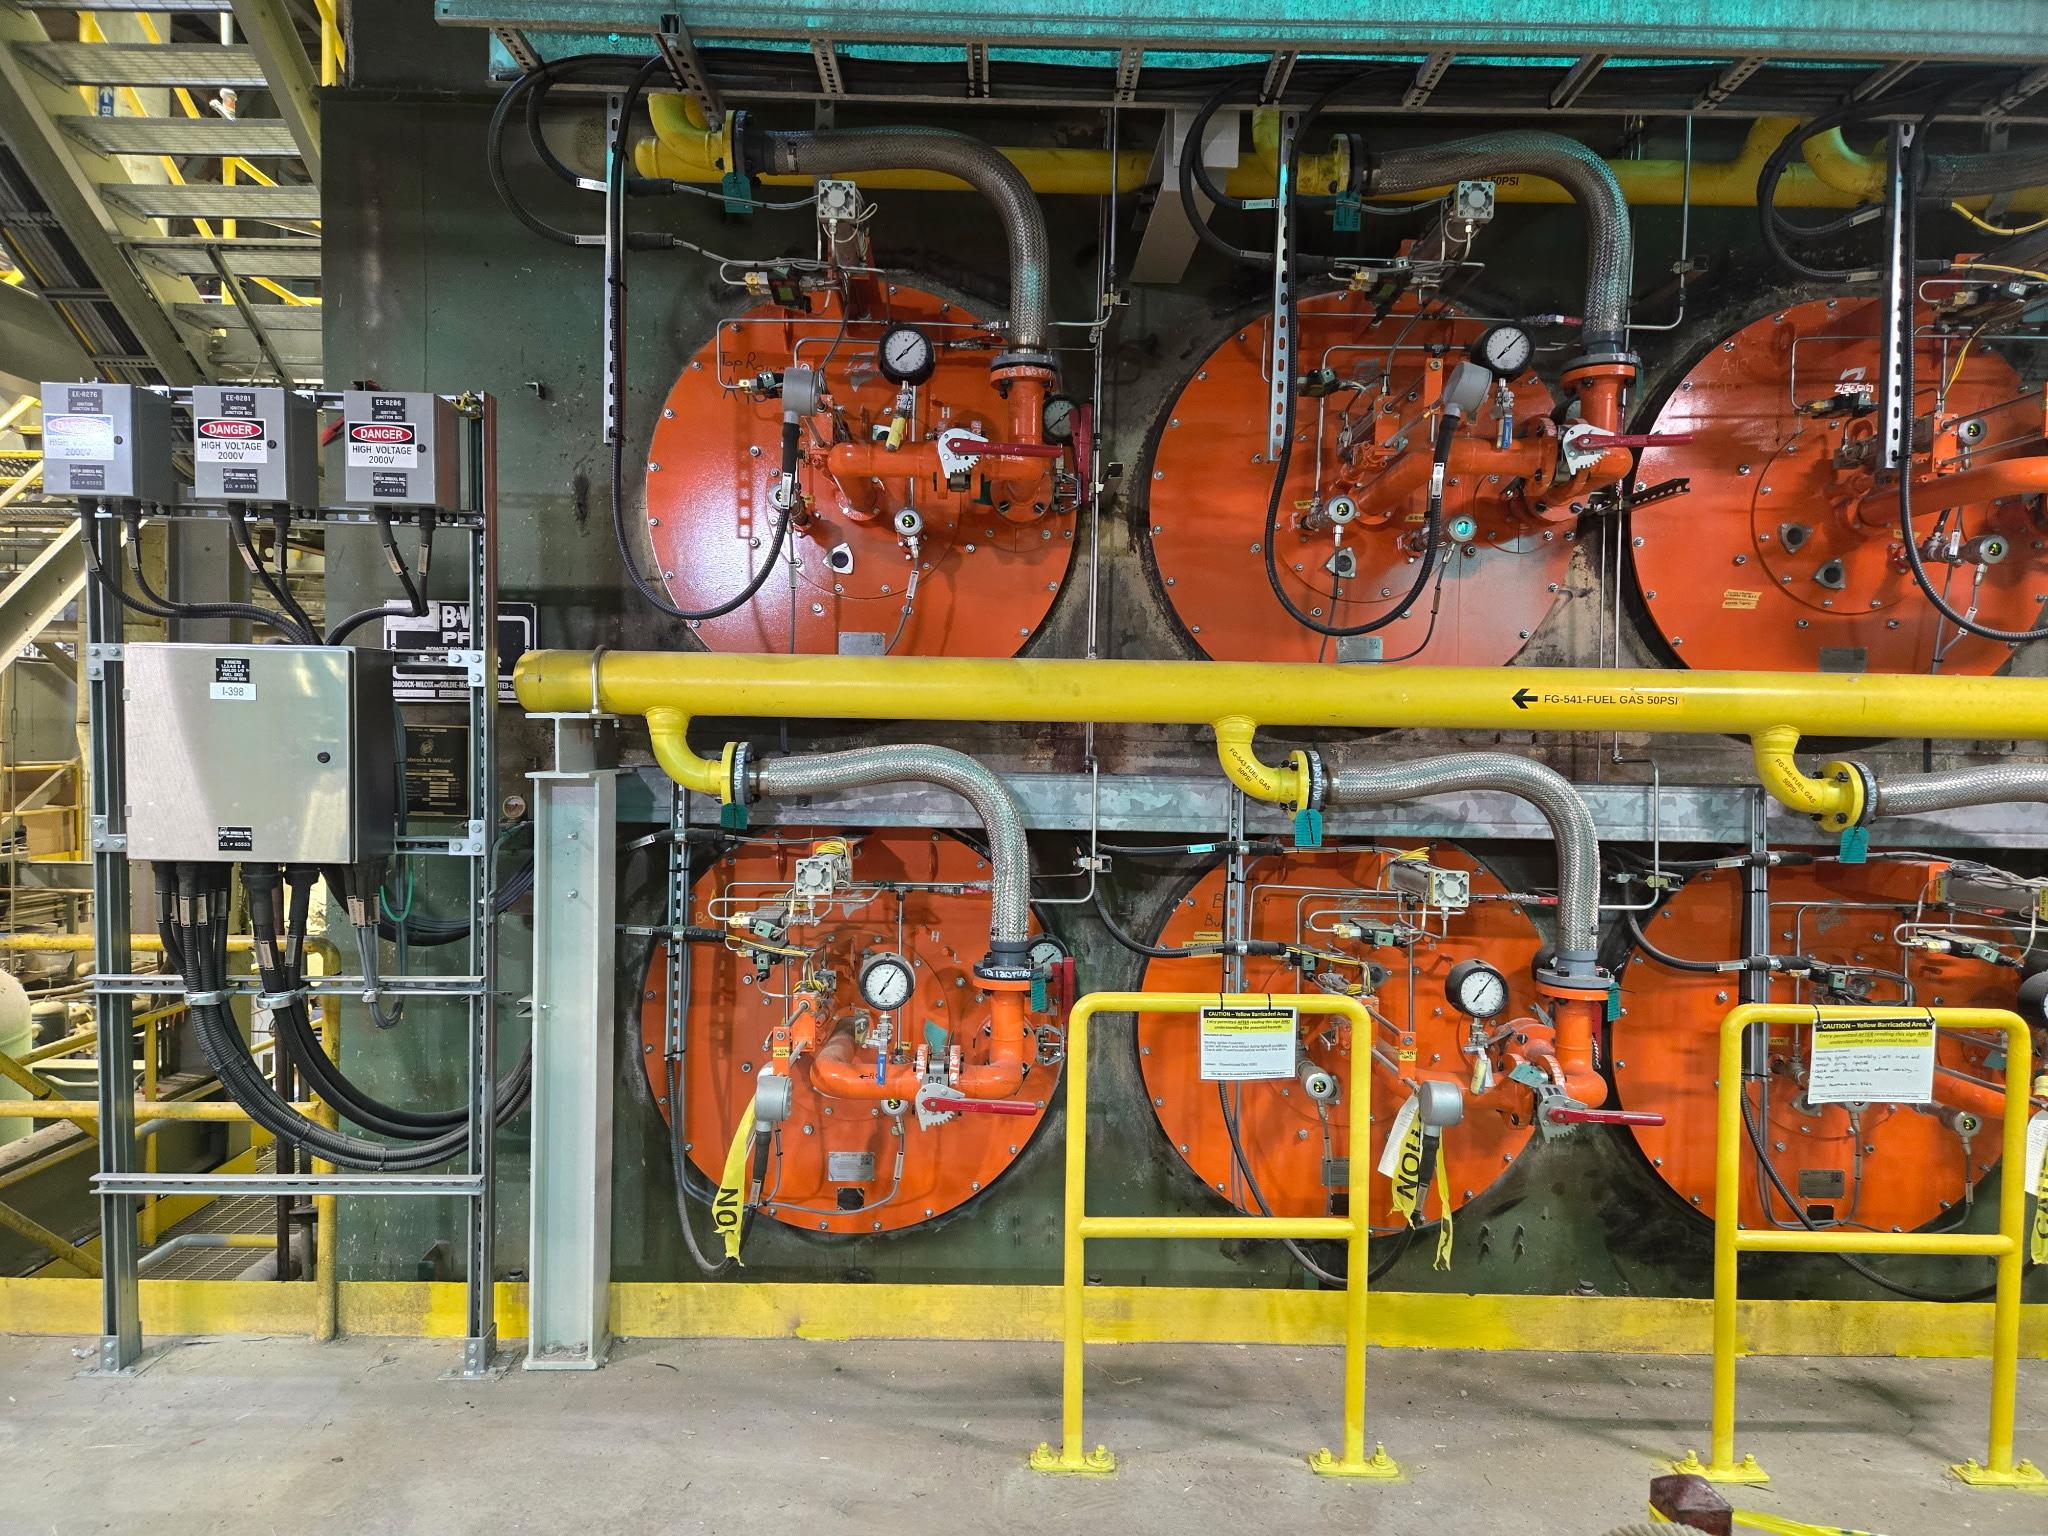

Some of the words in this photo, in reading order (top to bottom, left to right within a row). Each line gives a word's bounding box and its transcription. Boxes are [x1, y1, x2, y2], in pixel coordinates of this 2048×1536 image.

[226, 394, 251, 402] EE-8281
[375, 399, 402, 407] EE-8286
[208, 424, 252, 435] DANGER
[360, 429, 403, 440] DANGER
[201, 441, 221, 450] HIGH
[225, 441, 262, 451] VOLTAGE
[352, 446, 372, 454] HIGH
[376, 446, 412, 455] VOLTAGE
[218, 452, 245, 460] 2000V
[369, 456, 395, 464] 2000V
[222, 686, 244, 697] I-398
[1544, 693, 1617, 704] FG-541-FUEL
[1619, 694, 1645, 705] GAS
[1647, 695, 1679, 706] 50PSI
[1236, 766, 1253, 783] 50PSI
[1258, 778, 1272, 792] GAS
[1782, 777, 1798, 794] 50PSI
[1804, 790, 1817, 804] GAS
